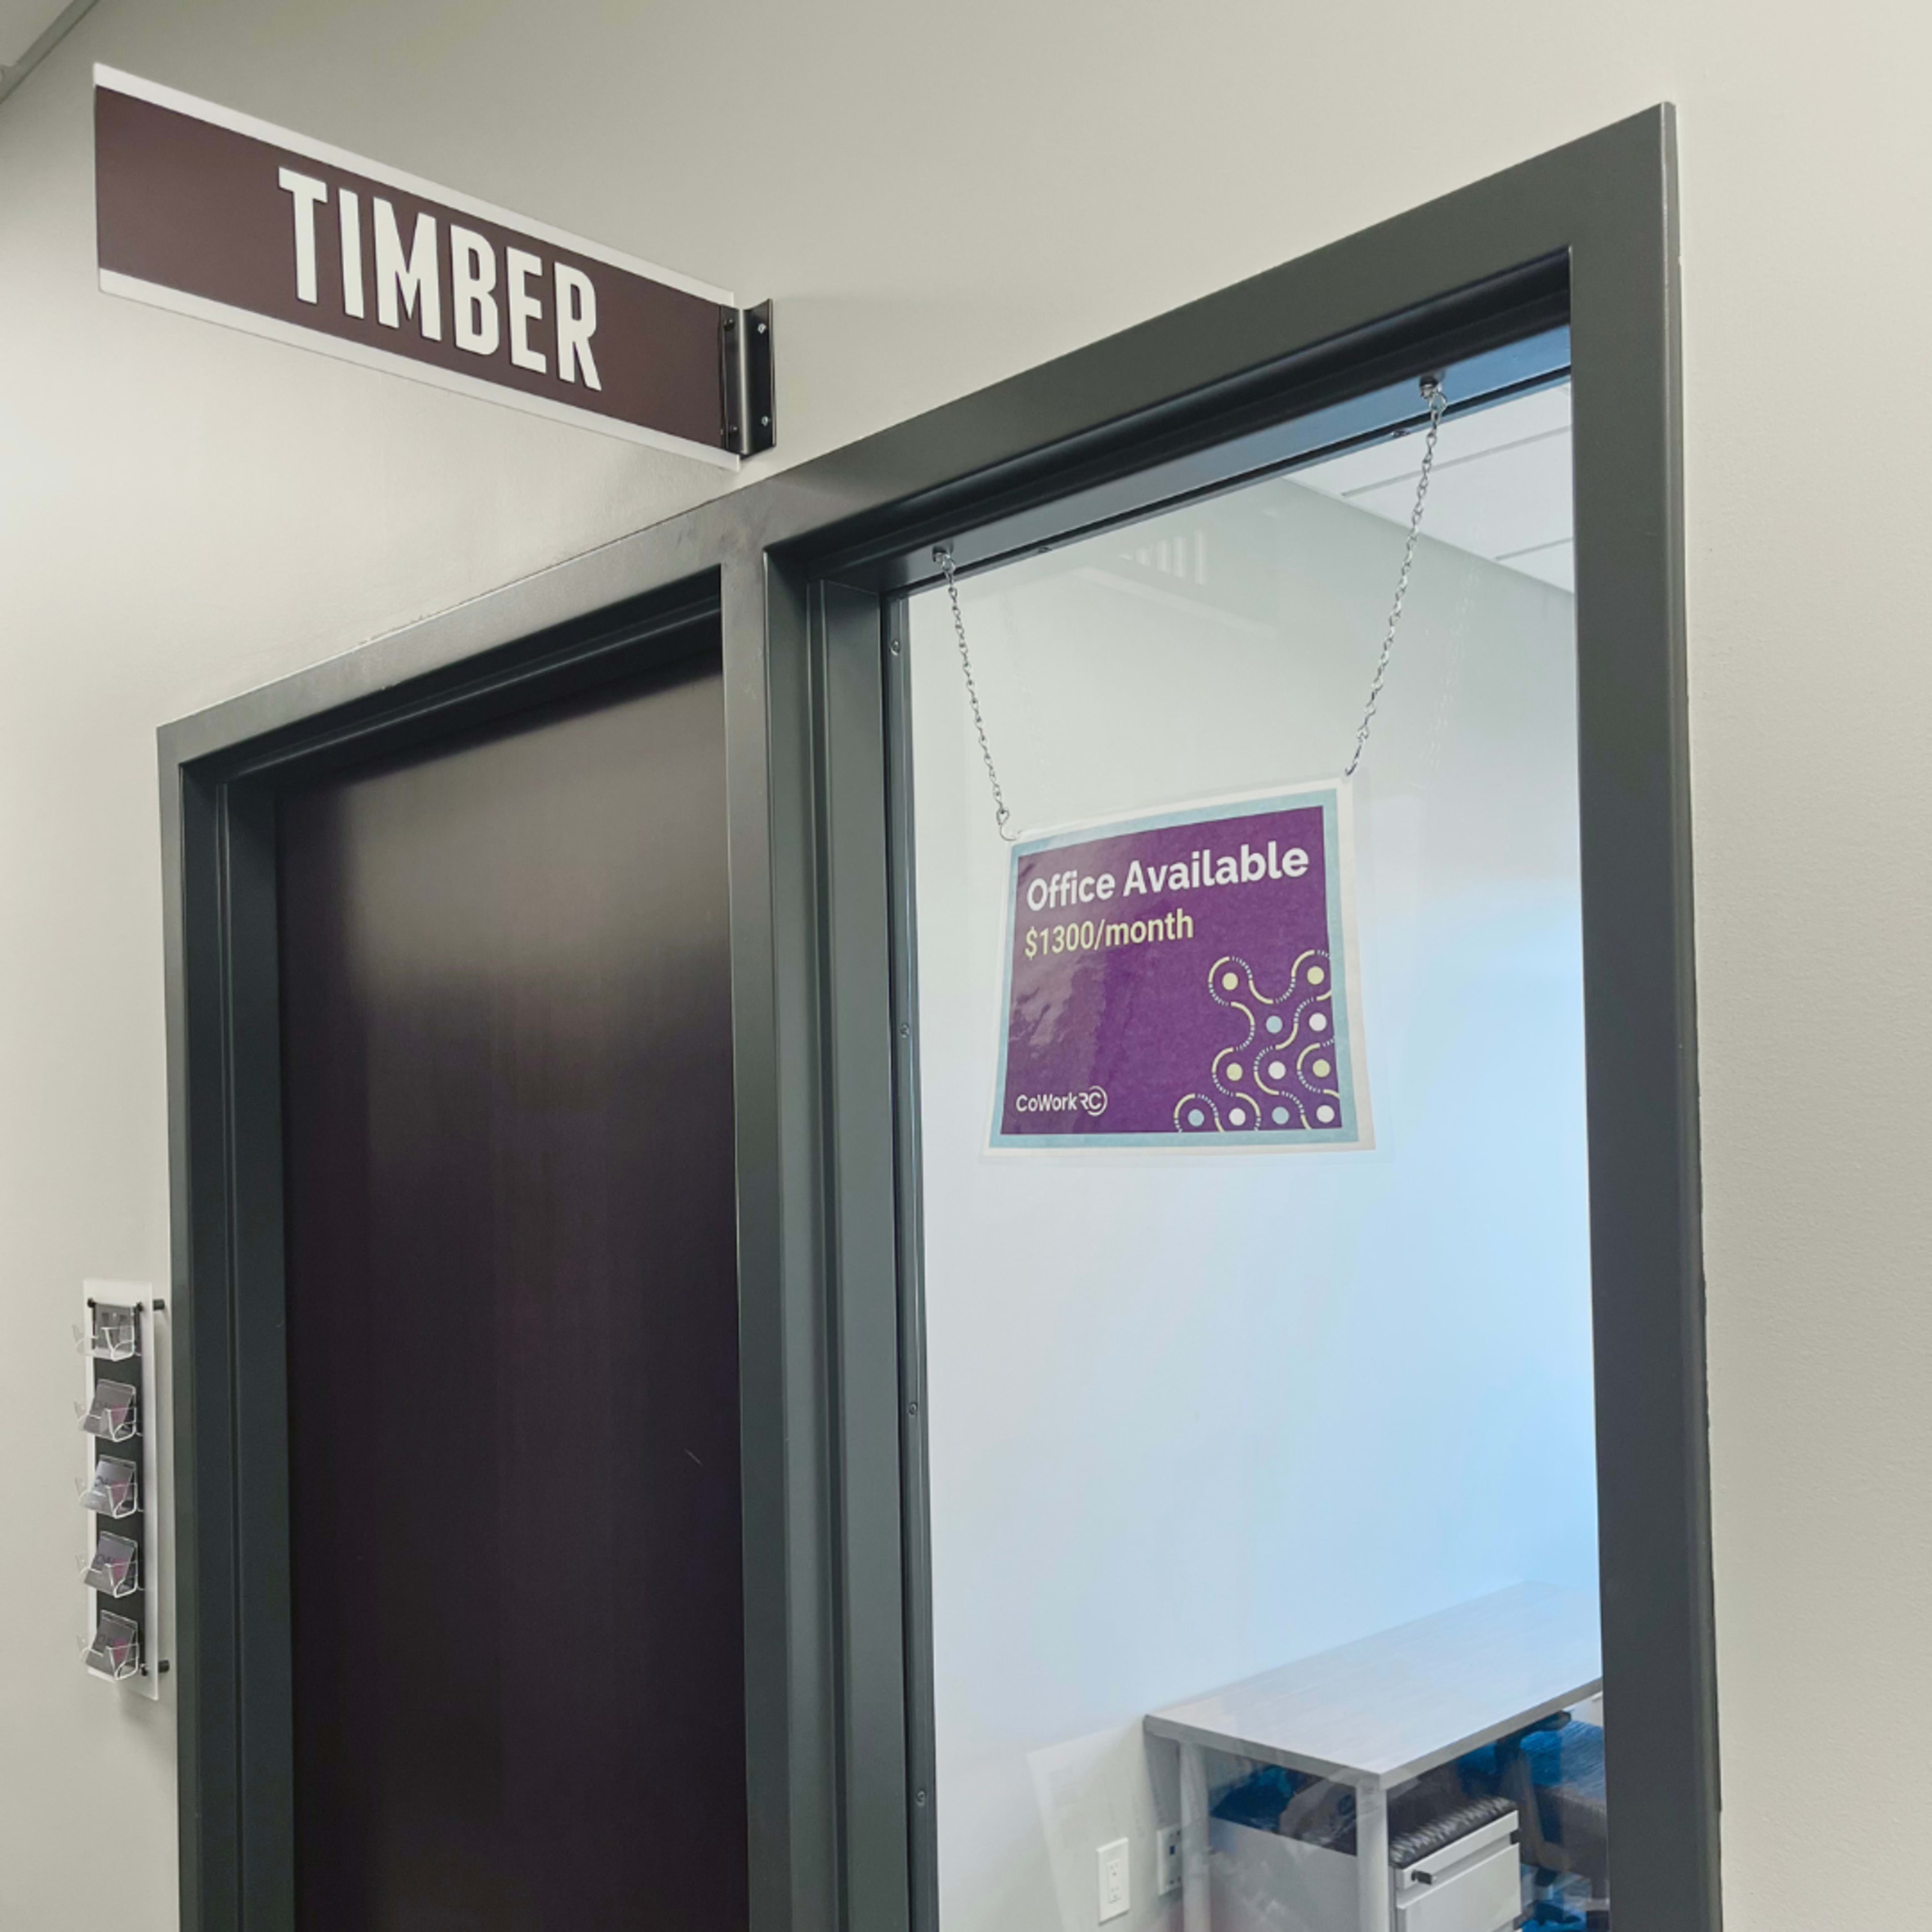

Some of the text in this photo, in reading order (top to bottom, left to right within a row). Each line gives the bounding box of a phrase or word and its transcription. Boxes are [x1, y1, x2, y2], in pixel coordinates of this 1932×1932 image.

[278, 167, 602, 391] TIMBER
[1027, 841, 1309, 911] Office Available
[1024, 908, 1194, 960] $1300/month
